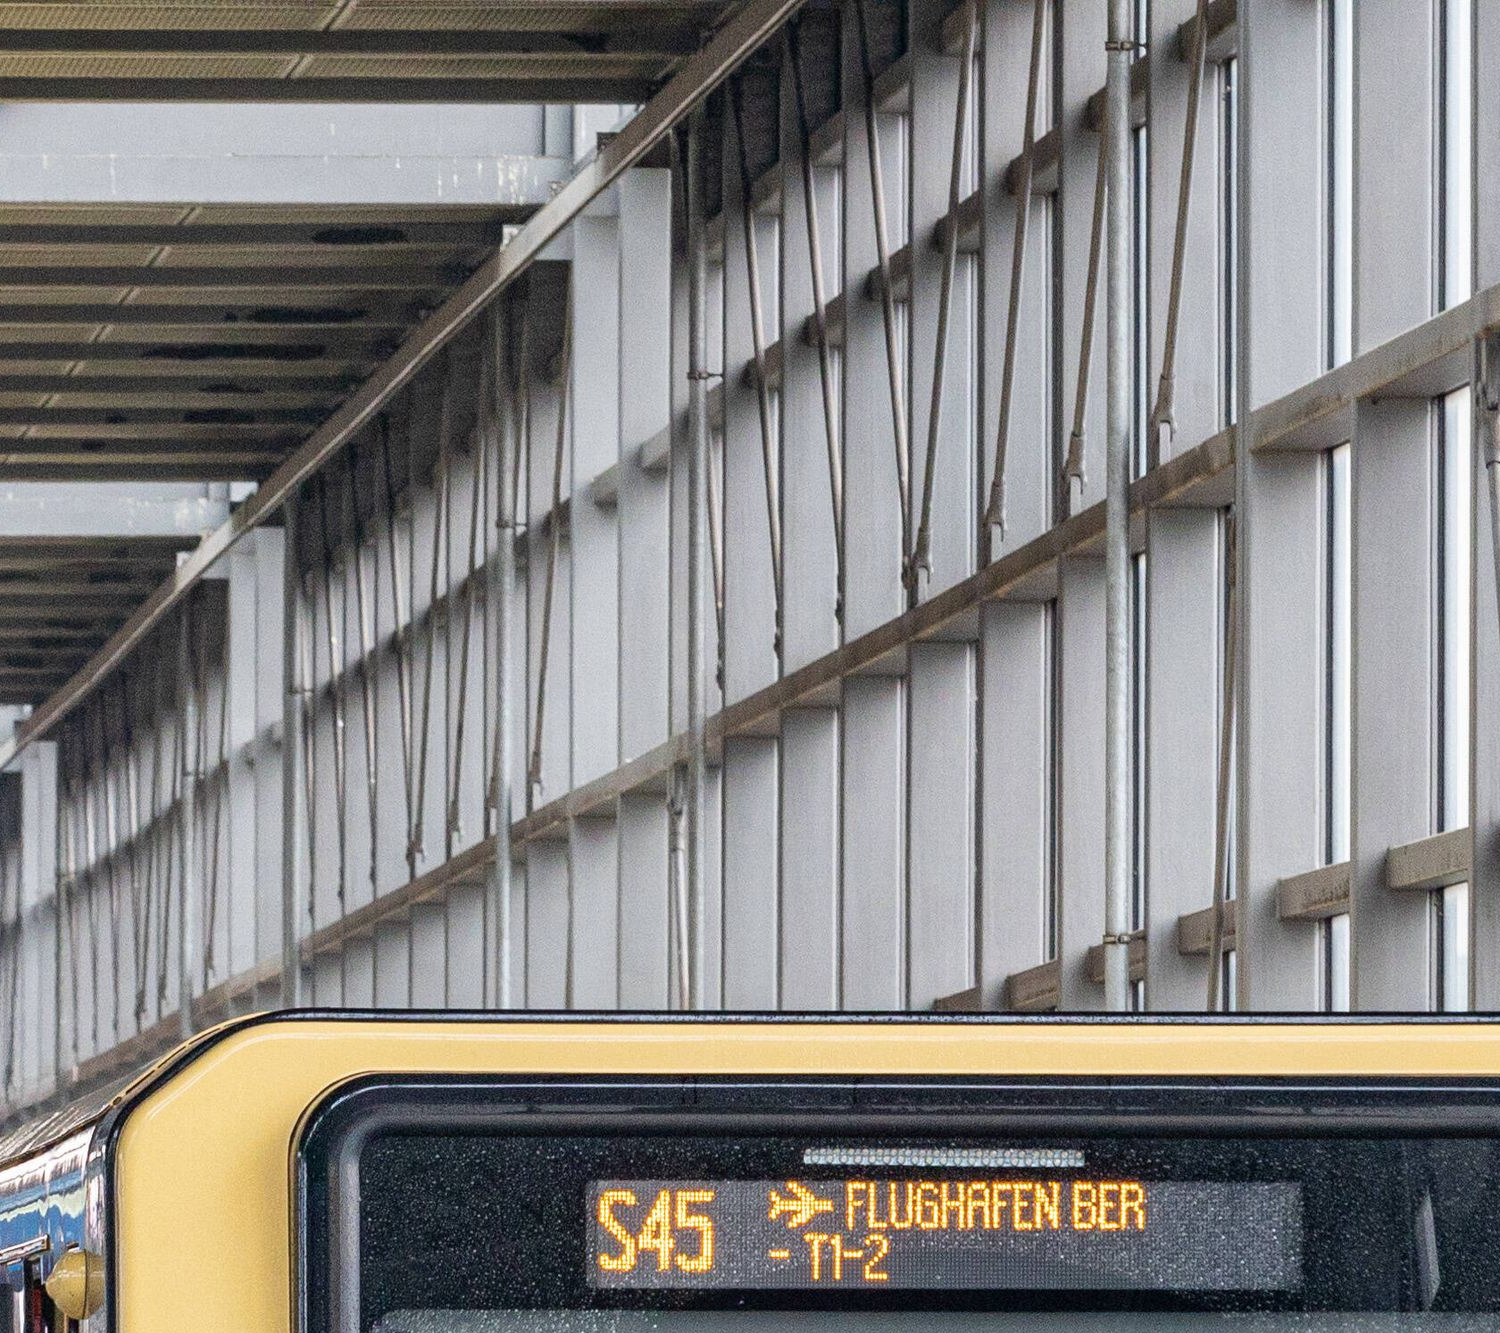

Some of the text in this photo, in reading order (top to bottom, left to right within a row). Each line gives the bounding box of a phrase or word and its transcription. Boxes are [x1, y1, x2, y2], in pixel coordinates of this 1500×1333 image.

[597, 1180, 1147, 1273] S45 FLUGHAFEN BER
[802, 1232, 889, 1281] T1-2
